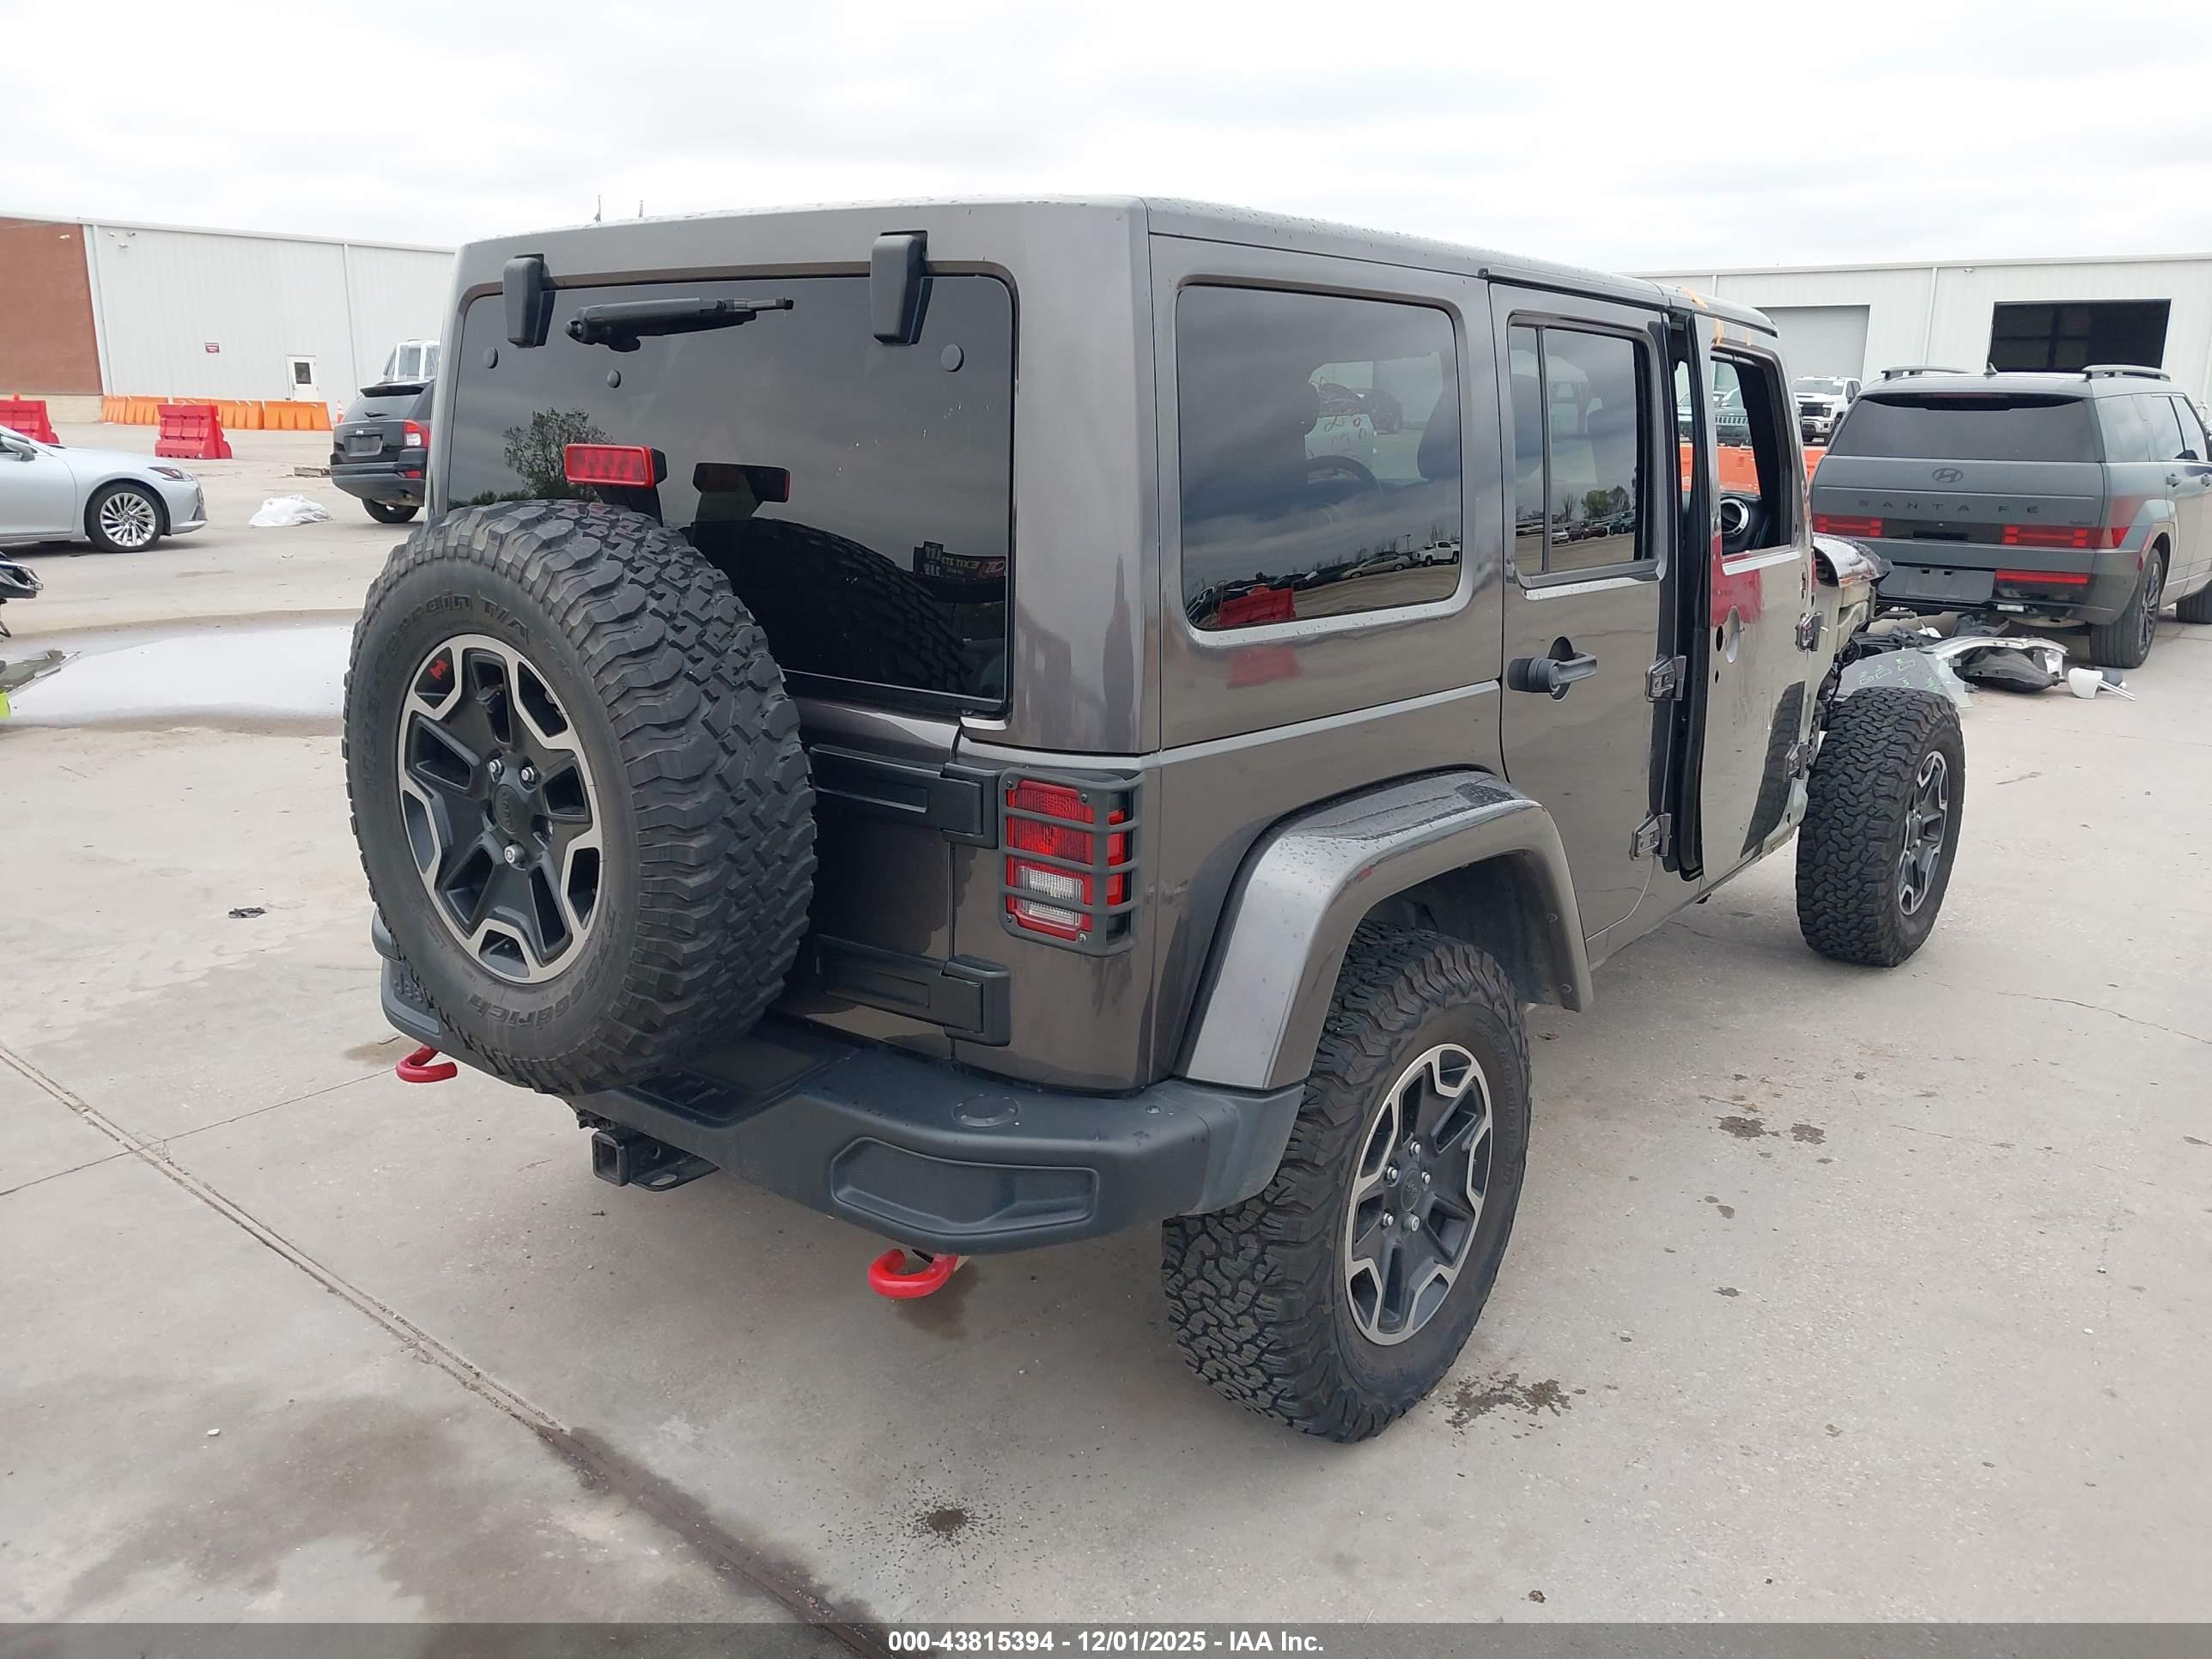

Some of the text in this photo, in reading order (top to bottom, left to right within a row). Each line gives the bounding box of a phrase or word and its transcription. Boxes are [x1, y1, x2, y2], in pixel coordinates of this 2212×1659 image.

[1858, 500, 2039, 514] SANTA FE
[393, 972, 425, 1004] Jee
